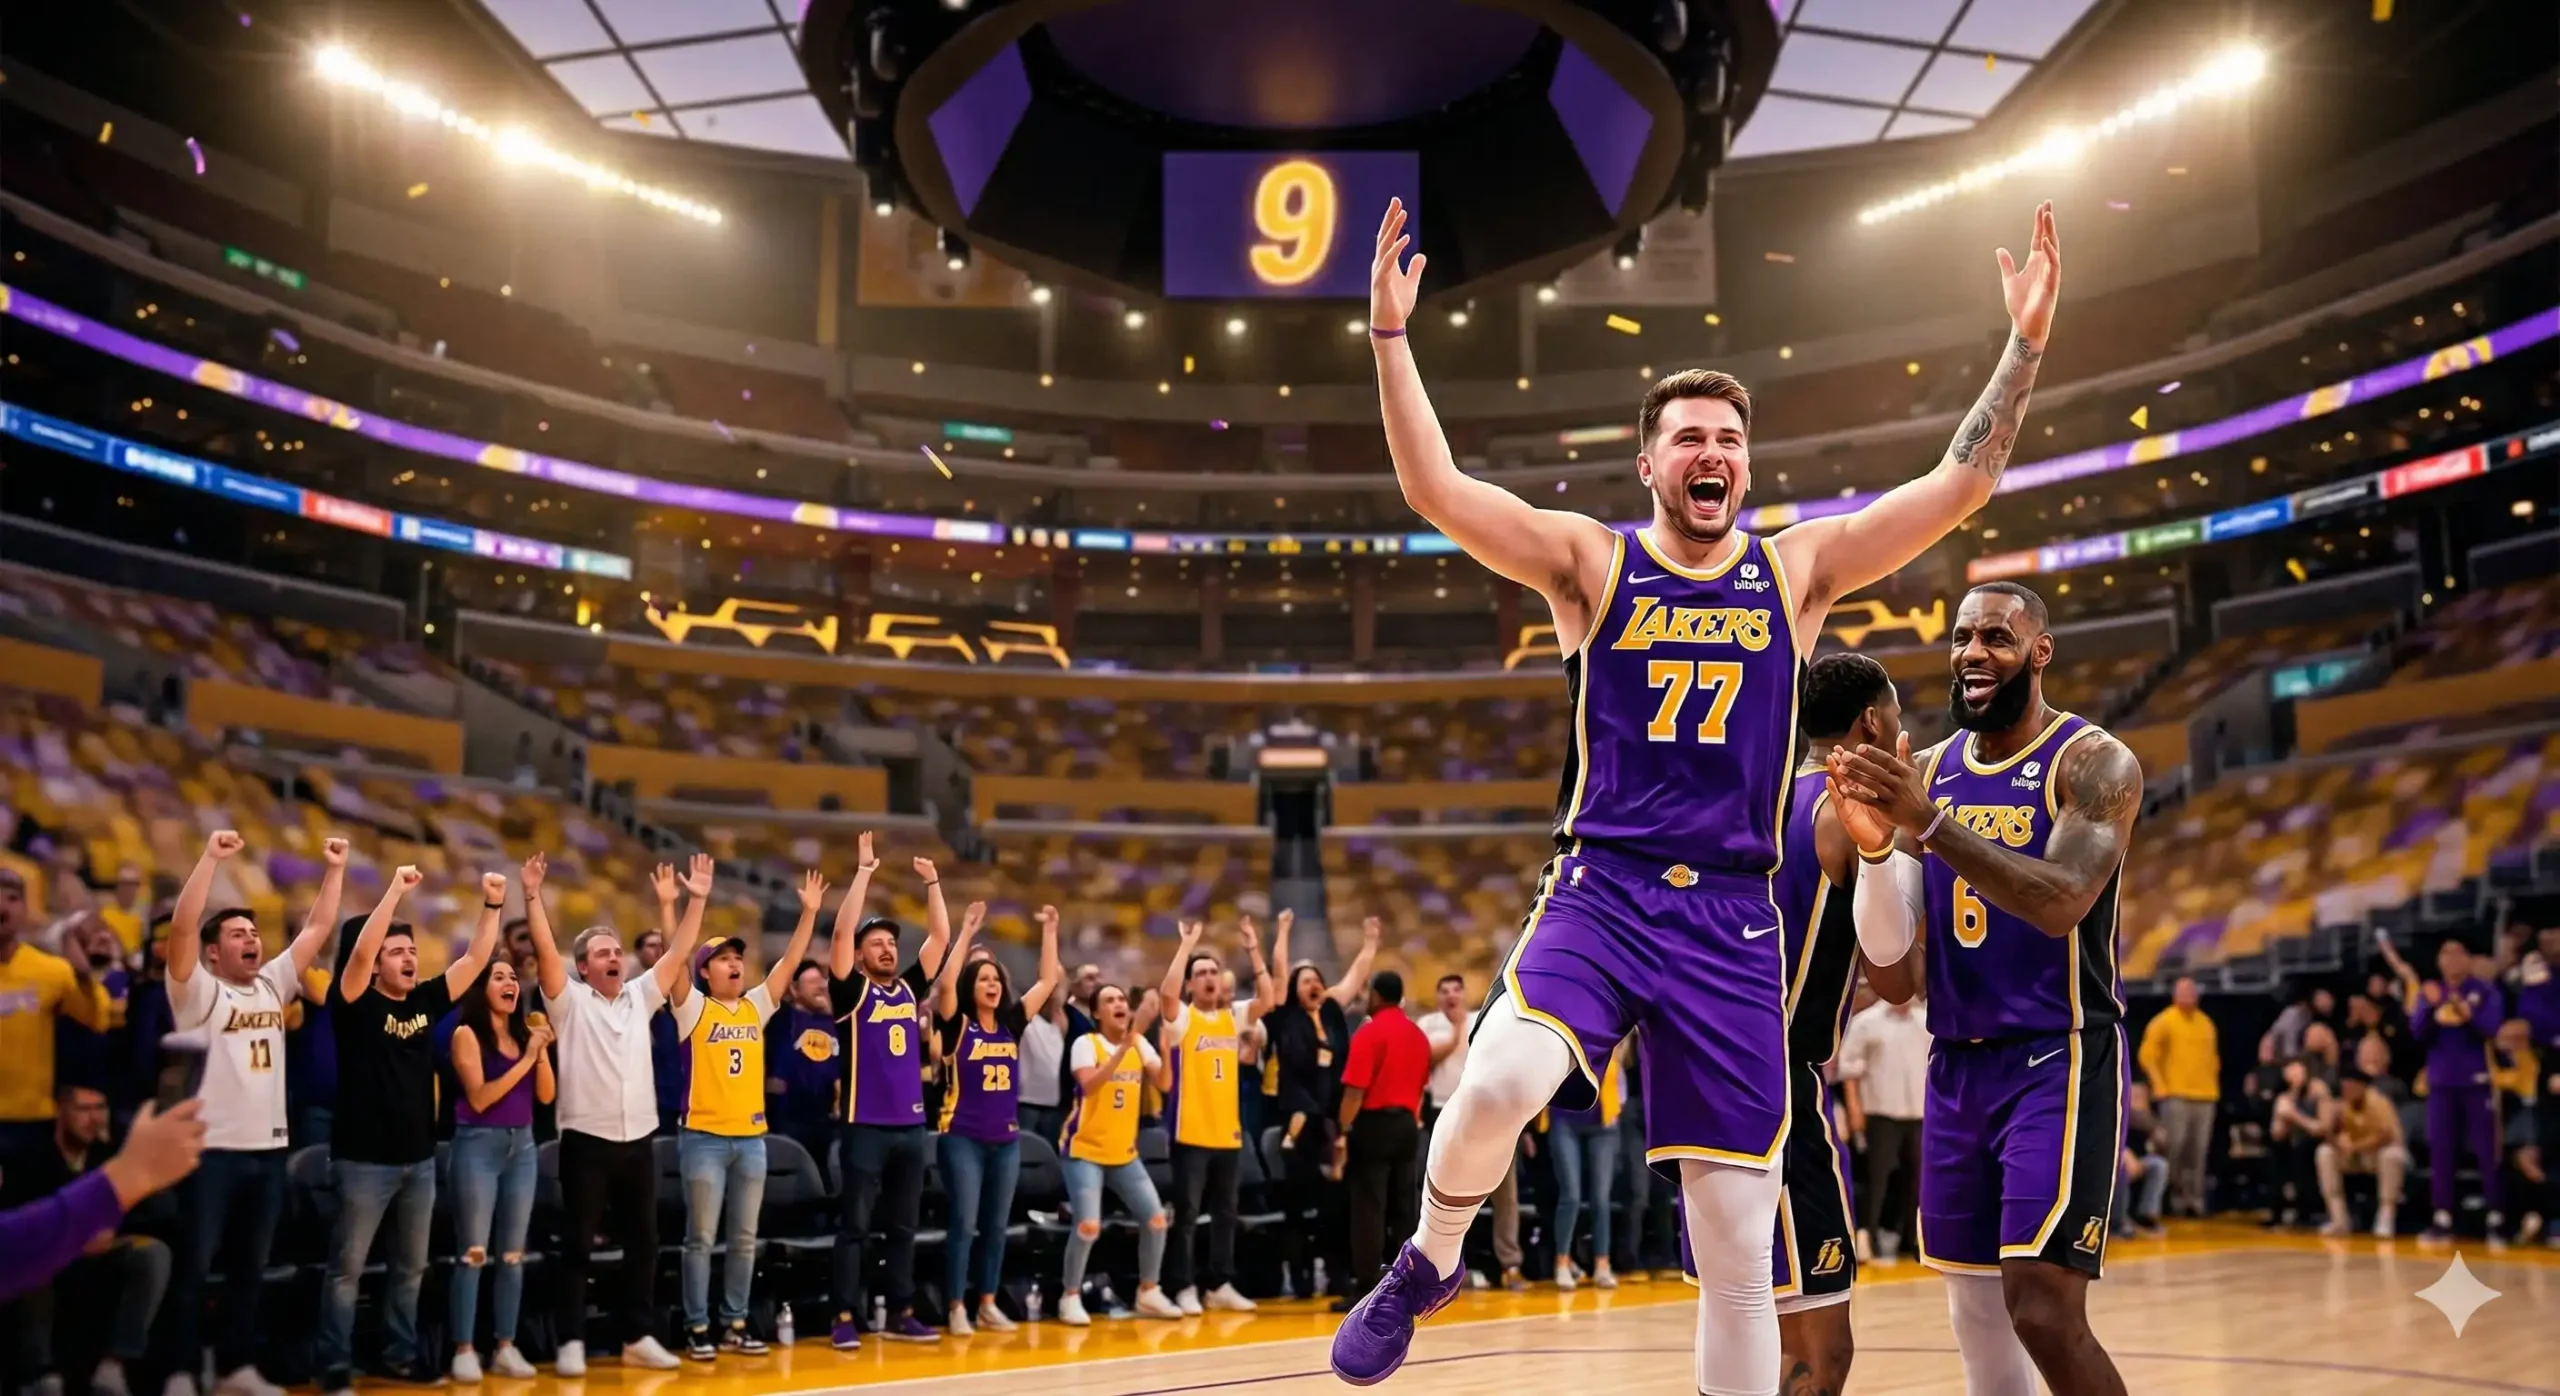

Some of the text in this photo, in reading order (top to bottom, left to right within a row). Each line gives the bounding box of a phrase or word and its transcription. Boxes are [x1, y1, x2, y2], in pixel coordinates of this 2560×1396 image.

[1250, 161, 1336, 285] 9
[1611, 597, 1771, 651] LAKERS
[1648, 660, 1743, 744] 77
[1954, 875, 1987, 948] 6
[729, 1048, 743, 1076] 3
[1214, 1057, 1223, 1080] 1
